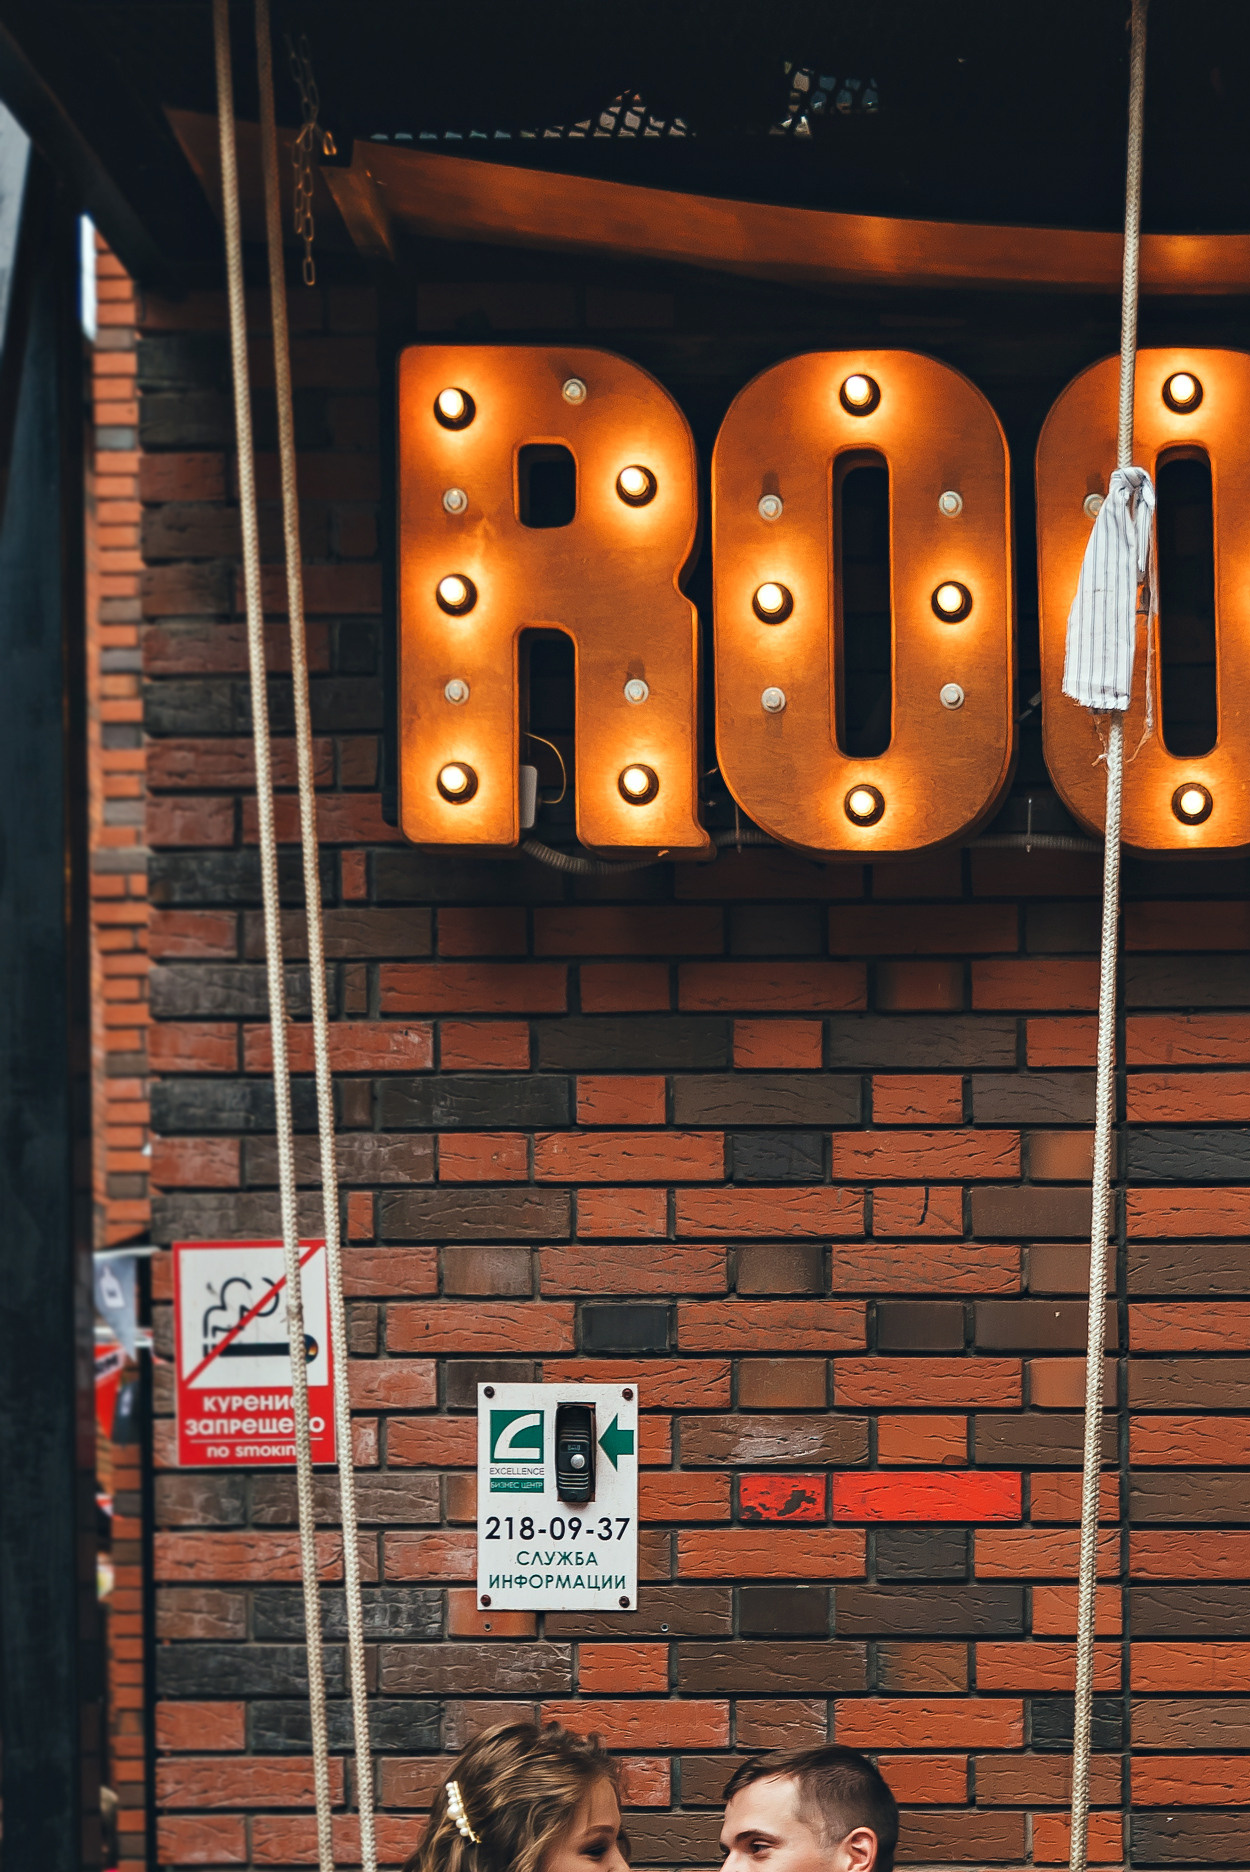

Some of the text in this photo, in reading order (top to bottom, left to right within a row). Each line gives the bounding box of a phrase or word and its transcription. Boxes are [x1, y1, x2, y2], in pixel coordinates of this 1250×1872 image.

[185, 1416, 325, 1436] запрещео
[206, 1446, 229, 1458] no
[235, 1445, 297, 1457] smokin
[489, 1467, 545, 1476] EXCELLENCE
[490, 1481, 544, 1489] БИЗНЕС ЦЕНТР
[485, 1516, 631, 1541] 218-09-37
[516, 1550, 599, 1566] СЛУЖБА
[488, 1574, 627, 1591] ИНФОРМАЦИИ
